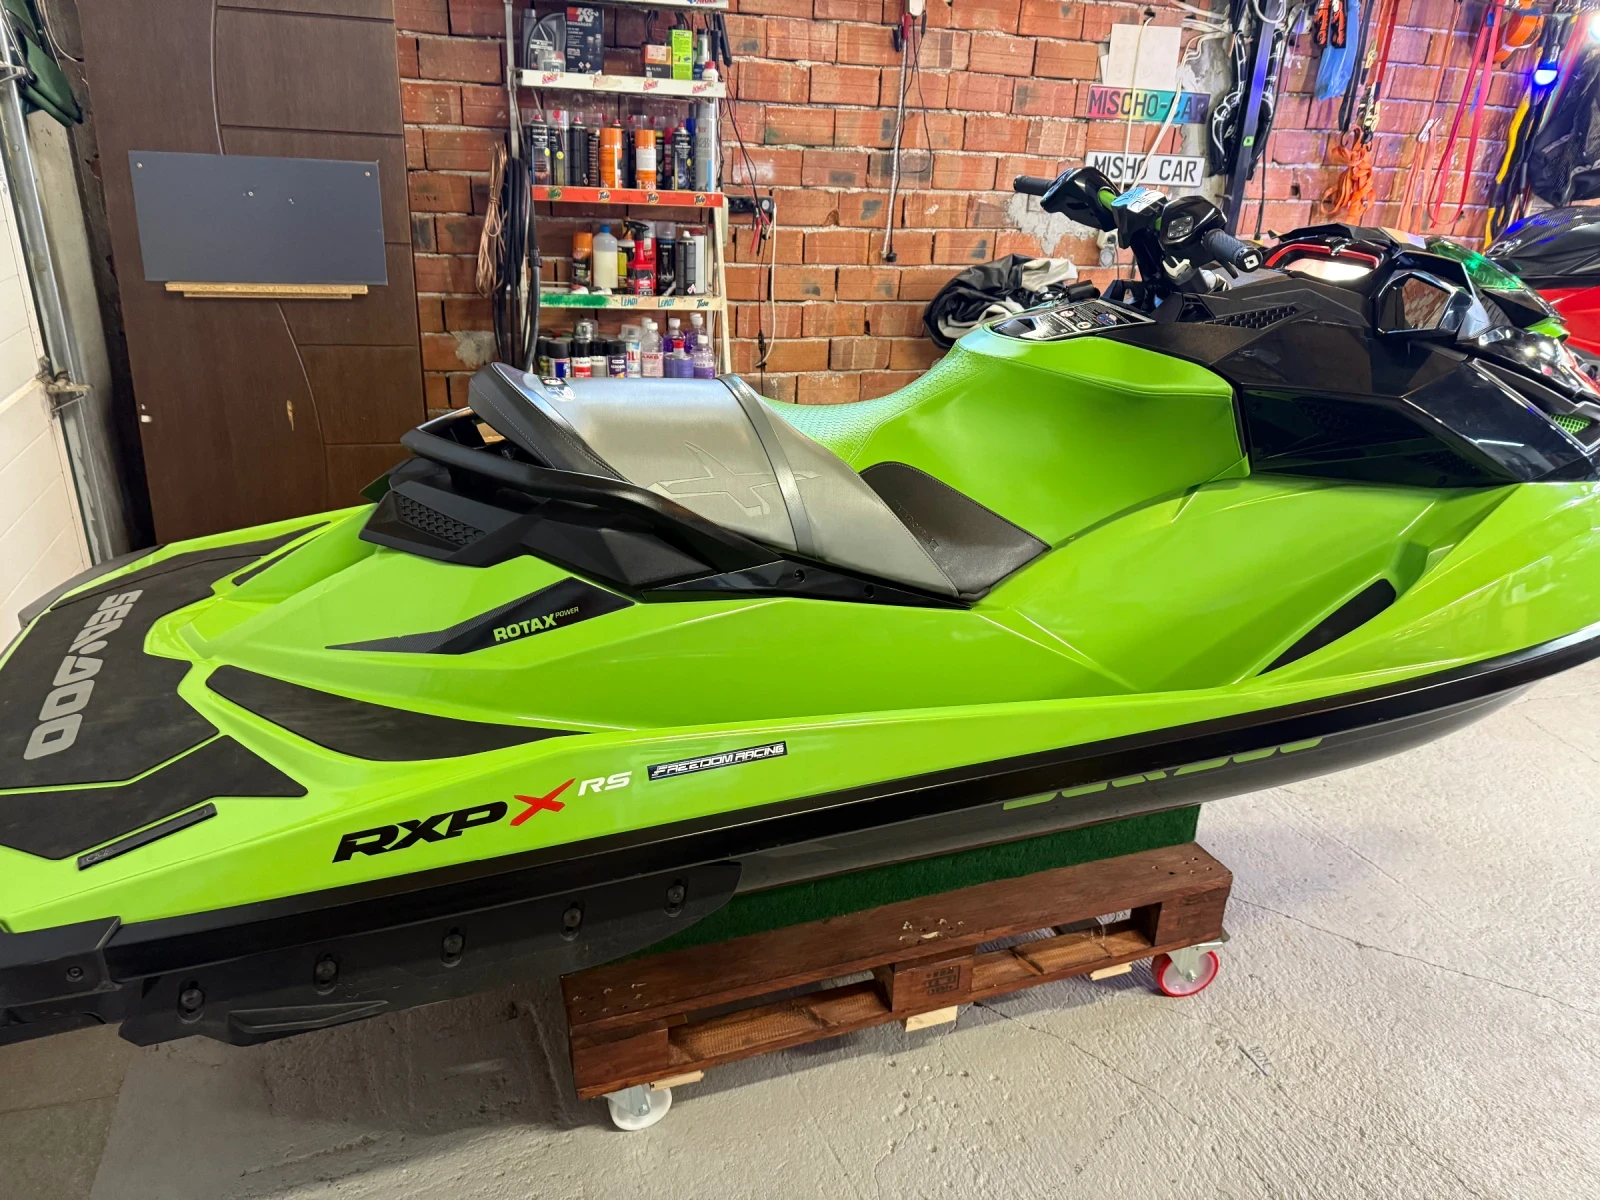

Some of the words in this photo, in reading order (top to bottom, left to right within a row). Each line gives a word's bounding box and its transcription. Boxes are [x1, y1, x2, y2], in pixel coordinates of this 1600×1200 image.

[1159, 159, 1197, 182] CAR
[493, 613, 557, 642] ROTAX
[555, 606, 579, 618] POWER
[651, 754, 734, 778] FREEDOM
[735, 743, 785, 761] RACING
[578, 771, 632, 796] RS
